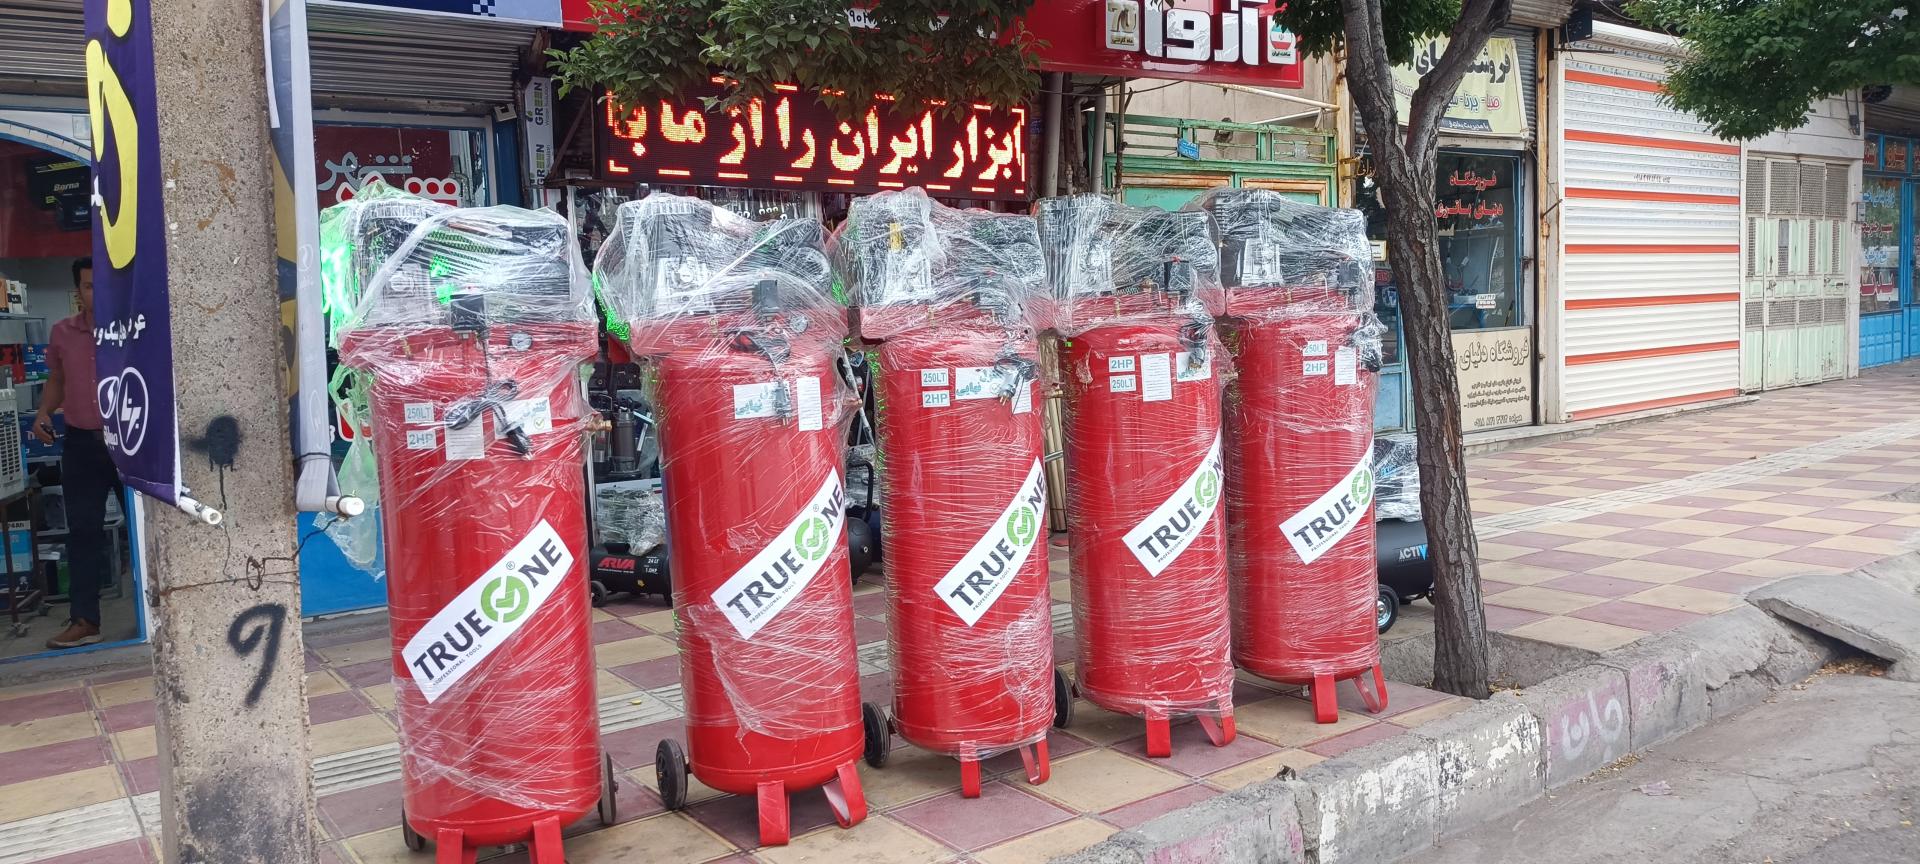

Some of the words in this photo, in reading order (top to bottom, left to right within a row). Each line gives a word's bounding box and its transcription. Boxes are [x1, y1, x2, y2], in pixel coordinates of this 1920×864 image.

[533, 82, 544, 127] GREEN
[659, 99, 706, 144] ما
[719, 97, 763, 165] از
[776, 97, 816, 169] را
[831, 106, 933, 175] ایران
[944, 114, 1022, 181] ابزار
[53, 181, 80, 192] Borna
[1450, 169, 1497, 191] فروشگاه
[1434, 199, 1472, 219] باتری
[1474, 199, 1504, 220] دنیای
[1460, 340, 1488, 371] دنیای
[1490, 335, 1530, 366] فروشگاه
[1111, 359, 1133, 369] 2HP
[1304, 363, 1326, 372] 2HP
[923, 372, 946, 383] 250LT
[1112, 378, 1134, 389] 250LT
[924, 393, 948, 404] 2HP
[406, 406, 433, 420] 250LT
[408, 432, 434, 445] 2HP
[598, 556, 636, 570] ARVA
[465, 643, 483, 659] TOOLS
